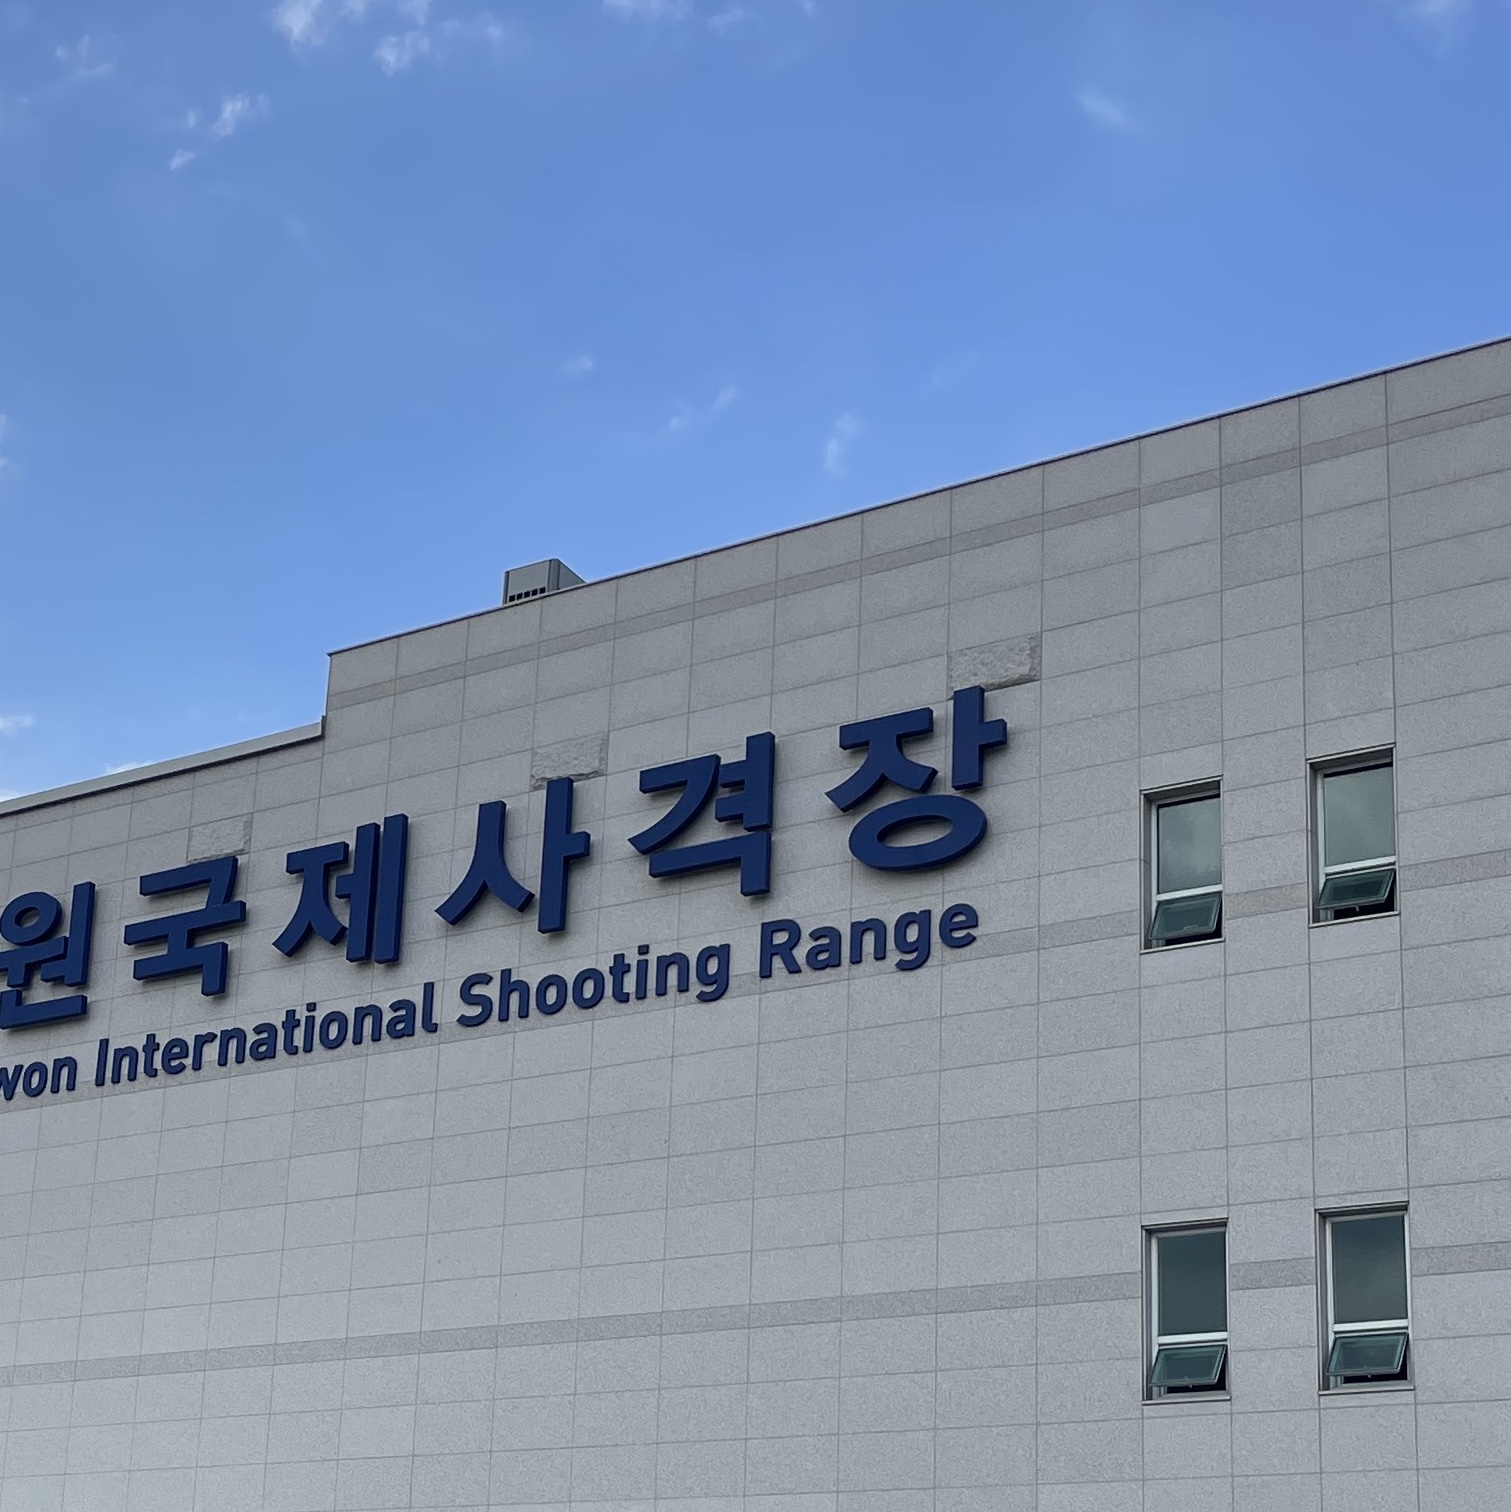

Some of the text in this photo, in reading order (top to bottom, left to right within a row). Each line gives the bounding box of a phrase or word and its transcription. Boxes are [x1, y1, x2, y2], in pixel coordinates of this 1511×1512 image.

[94, 982, 438, 1087] International
[456, 943, 730, 1028] Shooting
[759, 903, 979, 978] Range
